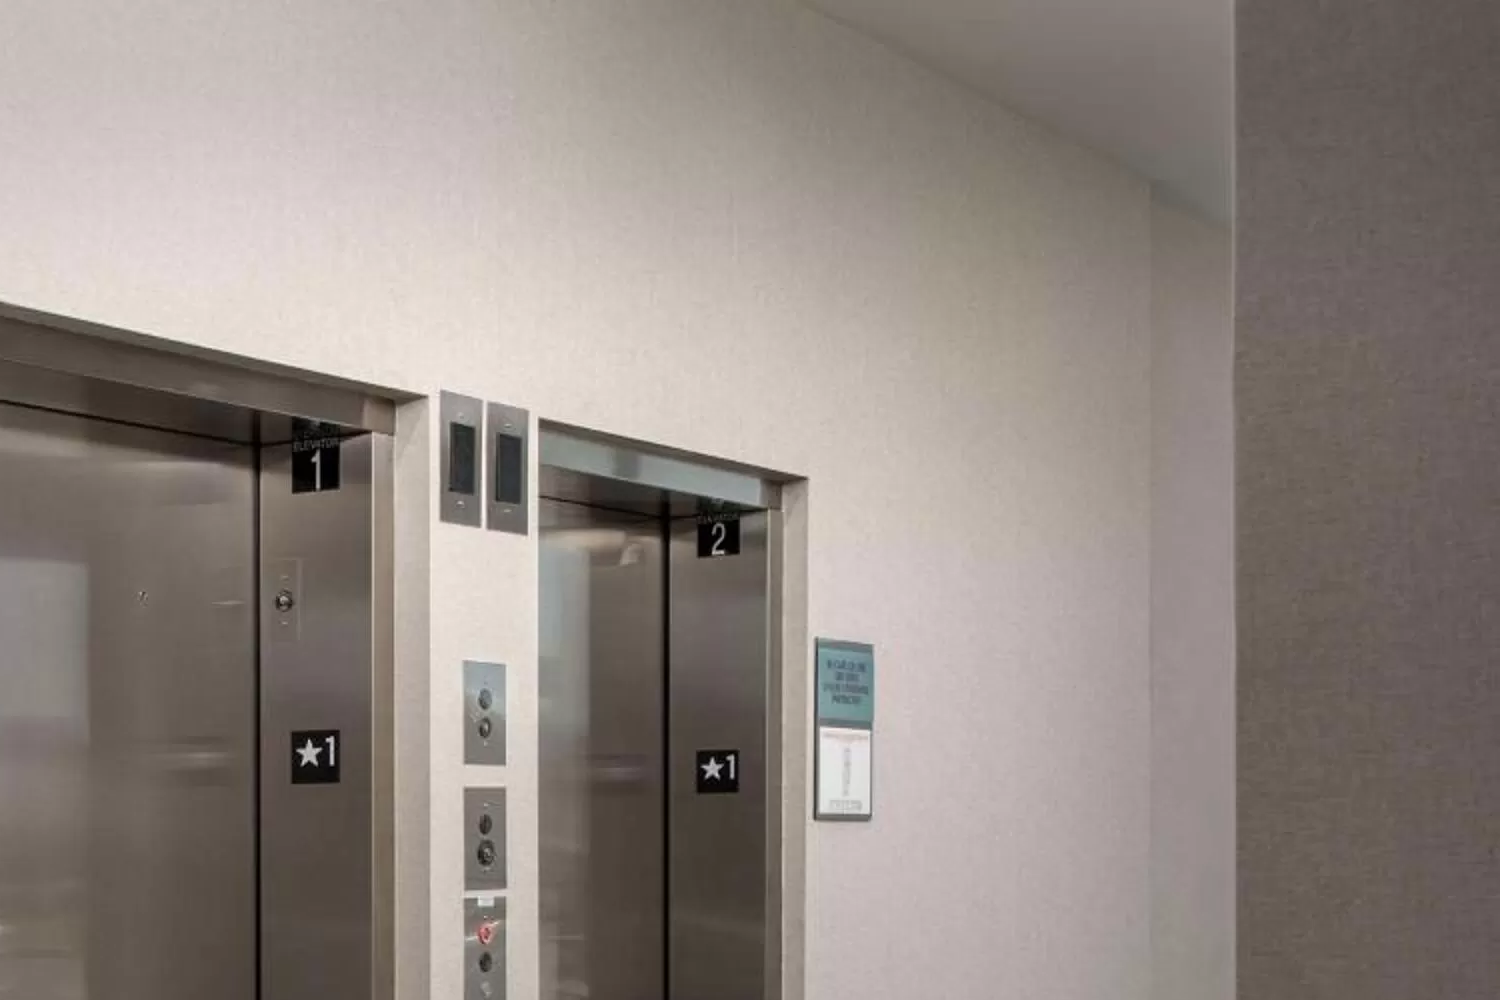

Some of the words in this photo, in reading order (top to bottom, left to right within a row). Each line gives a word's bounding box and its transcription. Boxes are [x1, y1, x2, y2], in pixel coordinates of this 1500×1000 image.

[311, 449, 321, 491] 1
[711, 522, 726, 556] 2
[325, 735, 335, 767] 1
[726, 754, 735, 780] 1
